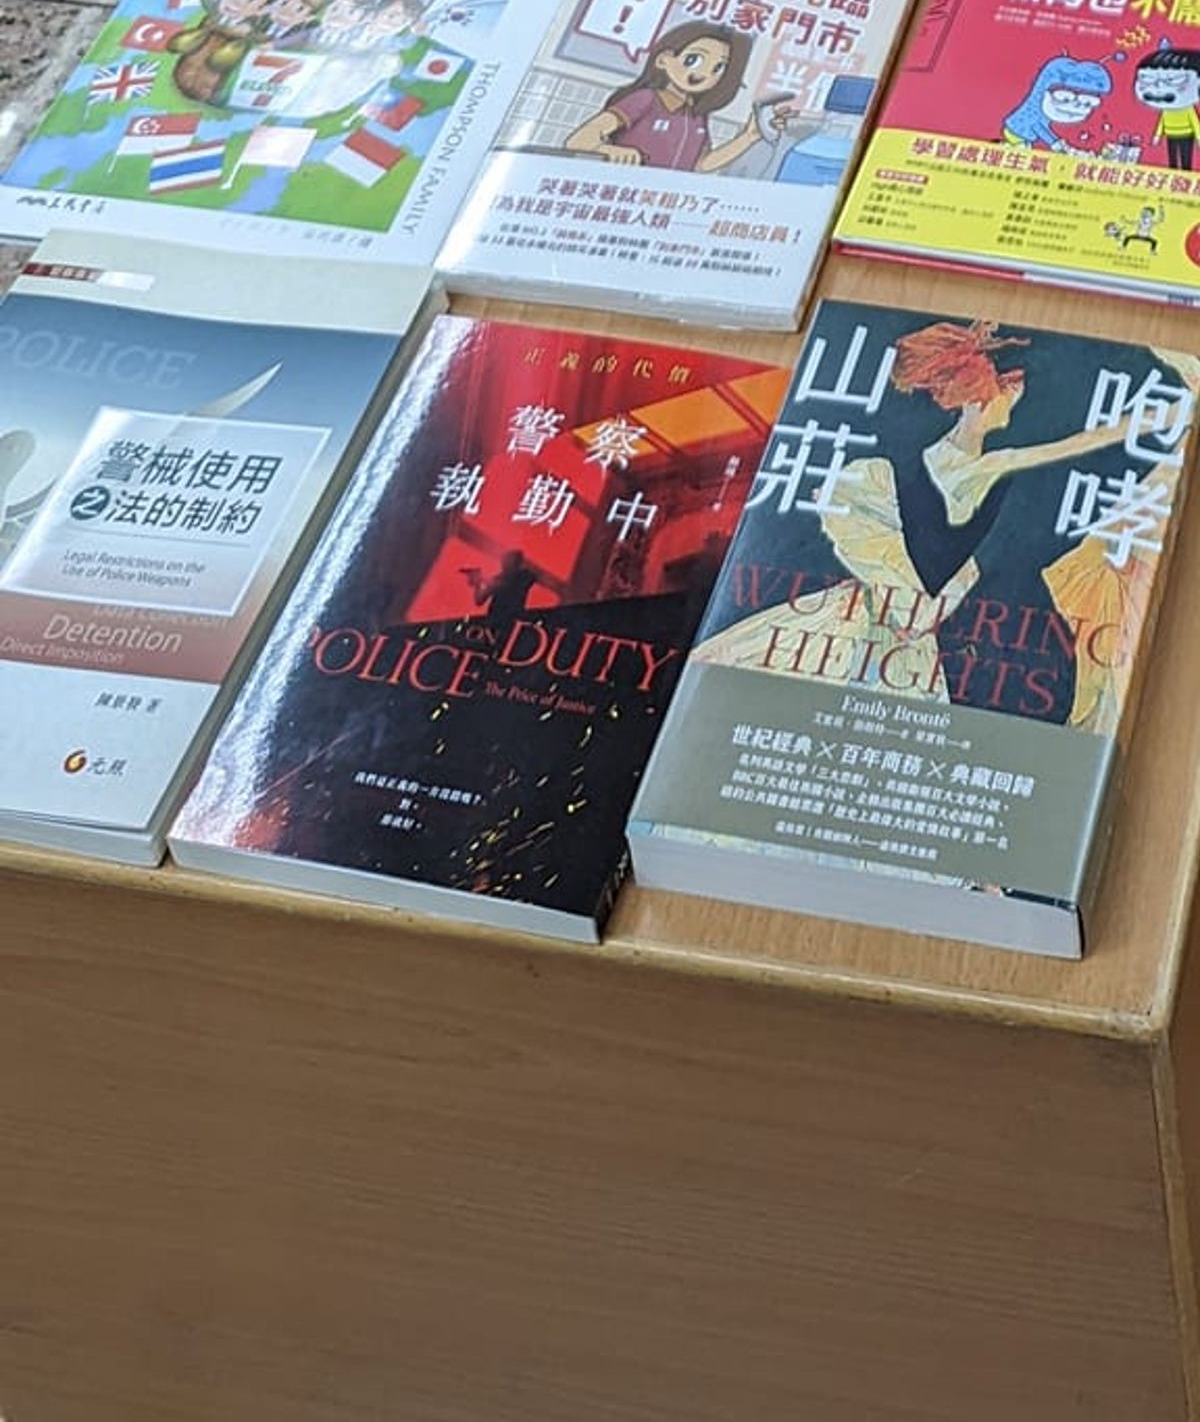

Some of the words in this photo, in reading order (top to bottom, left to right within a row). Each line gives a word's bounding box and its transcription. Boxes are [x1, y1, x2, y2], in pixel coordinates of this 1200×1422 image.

[438, 62, 500, 162] THOMPSON
[402, 166, 447, 236] FAMILY
[507, 401, 648, 472] 警察
[748, 324, 899, 517] 山莊
[97, 439, 285, 494] 警械使用
[430, 460, 660, 543] 執勤中
[1054, 366, 1194, 569] 咆哮
[43, 614, 183, 654] Detention
[732, 561, 1126, 670] WUTHERING
[499, 618, 679, 692] DUTY
[761, 624, 1060, 716] HEIGHTS
[841, 695, 888, 721] Emily
[893, 705, 951, 728] Brontë
[732, 723, 813, 756] 世紀經典
[840, 743, 925, 777] 百年商務
[949, 764, 1036, 798] 典藏回歸
